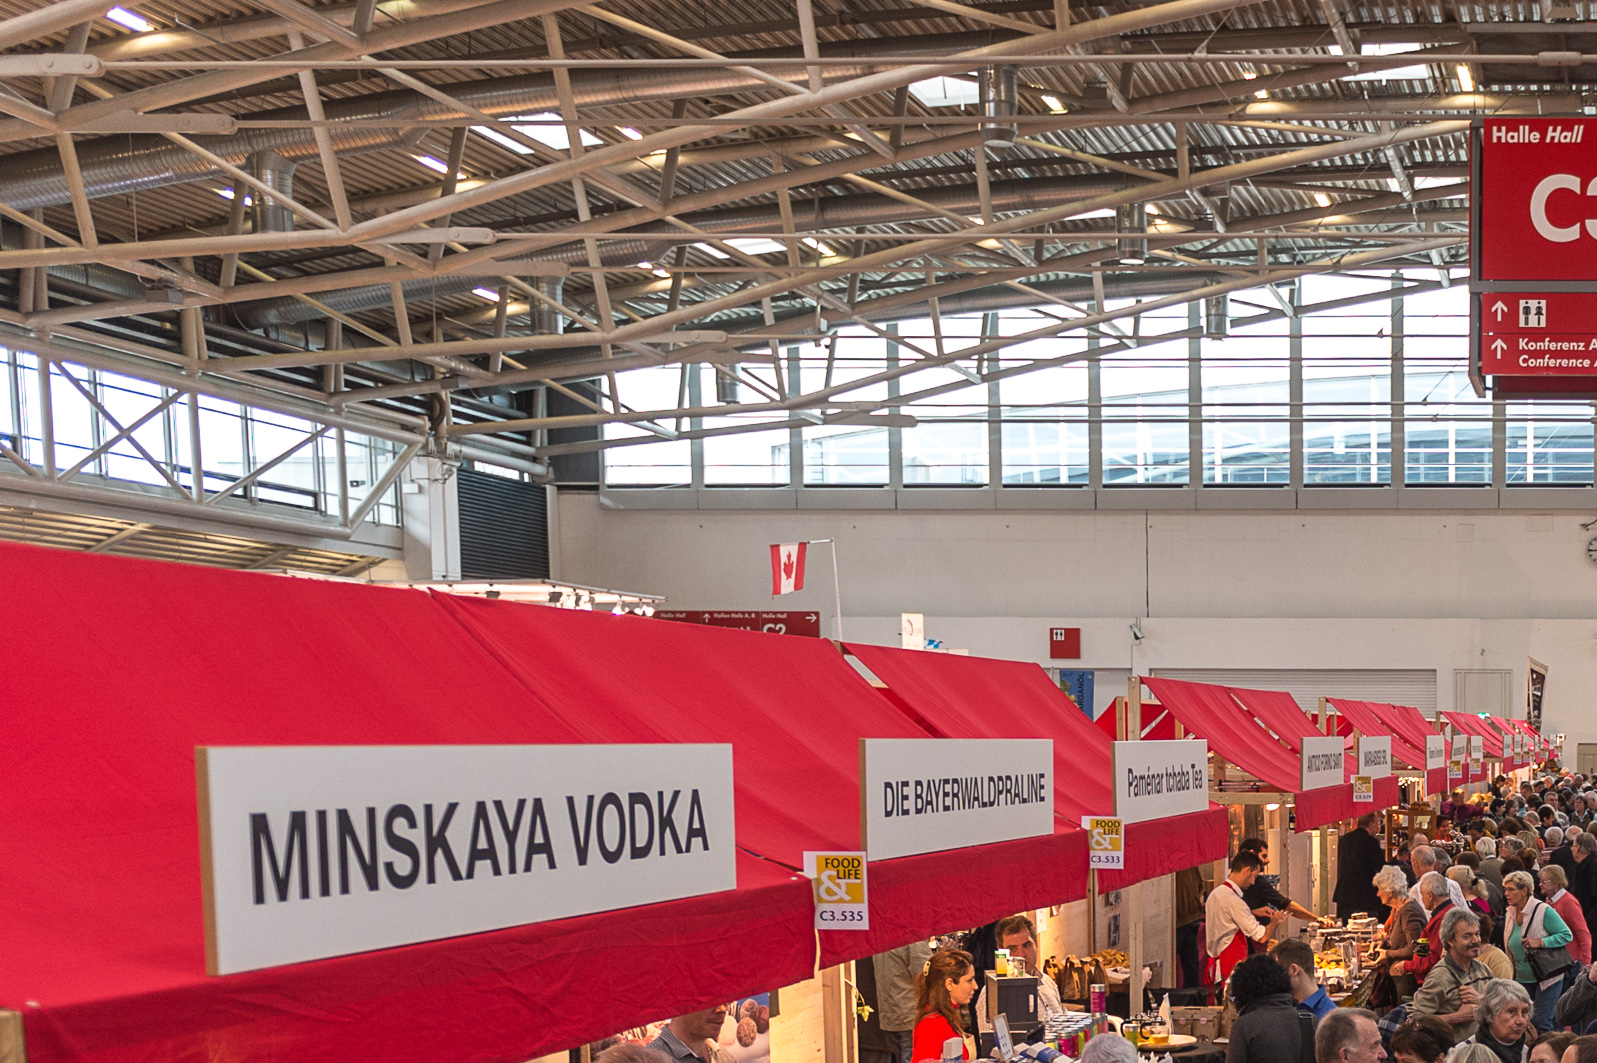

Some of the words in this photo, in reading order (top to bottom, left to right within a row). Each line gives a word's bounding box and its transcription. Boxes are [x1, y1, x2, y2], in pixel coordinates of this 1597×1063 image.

[1491, 125, 1541, 144] Halle
[1545, 124, 1585, 144] Hall
[1518, 338, 1586, 351] Konferenz
[1518, 355, 1591, 368] Conference
[1127, 765, 1164, 798] Paménar
[1165, 764, 1190, 793] tchaba
[1190, 763, 1203, 790] Tea
[883, 780, 911, 818] DIE
[913, 772, 1046, 815] BAYERWALDPRALINE
[1095, 820, 1120, 828] FOOD
[248, 796, 557, 906] MINSKAYA
[565, 788, 710, 867] VODKA
[825, 857, 861, 869] FOOD
[1090, 855, 1120, 863] C3.533
[836, 868, 861, 880] LIFE
[819, 910, 864, 922] C3.535
